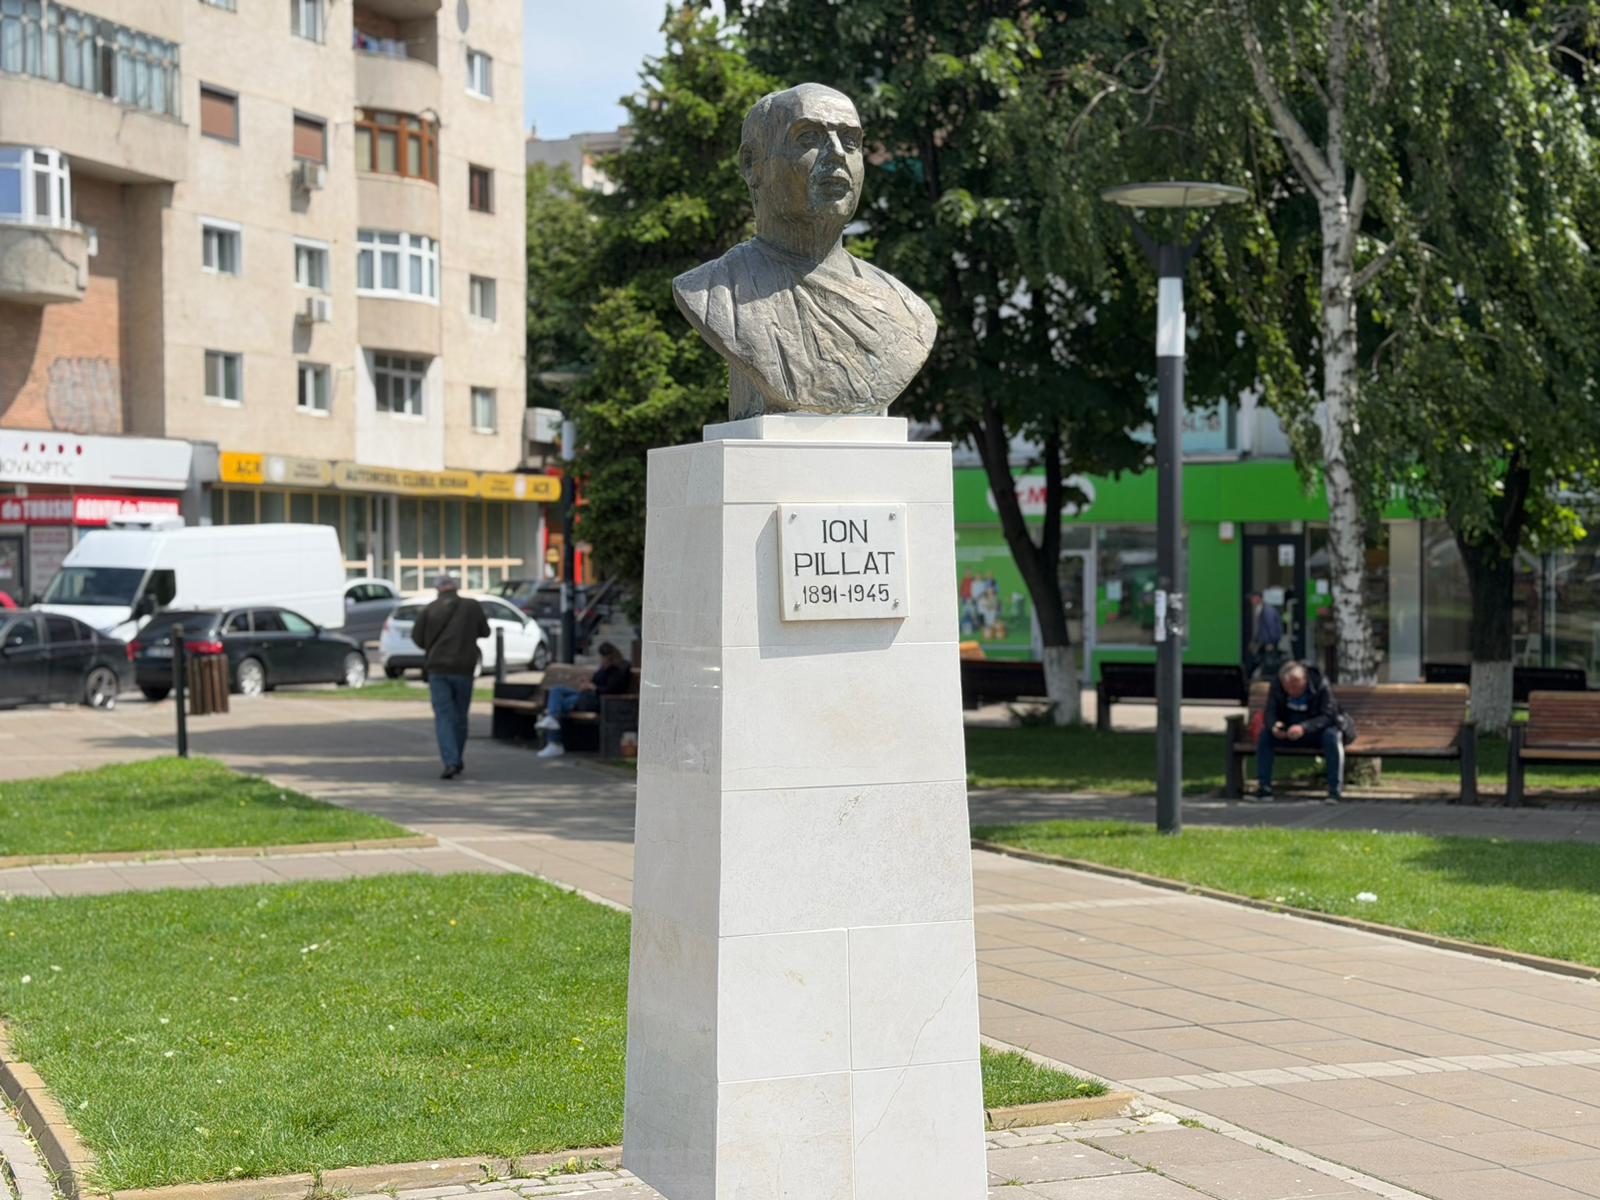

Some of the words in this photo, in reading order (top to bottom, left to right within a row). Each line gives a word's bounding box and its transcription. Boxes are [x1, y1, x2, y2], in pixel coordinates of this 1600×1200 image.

[0, 457, 73, 477] OVAOPTIC
[821, 519, 868, 544] ION
[793, 551, 896, 576] PILLAT
[802, 583, 890, 604] 1891-1945
